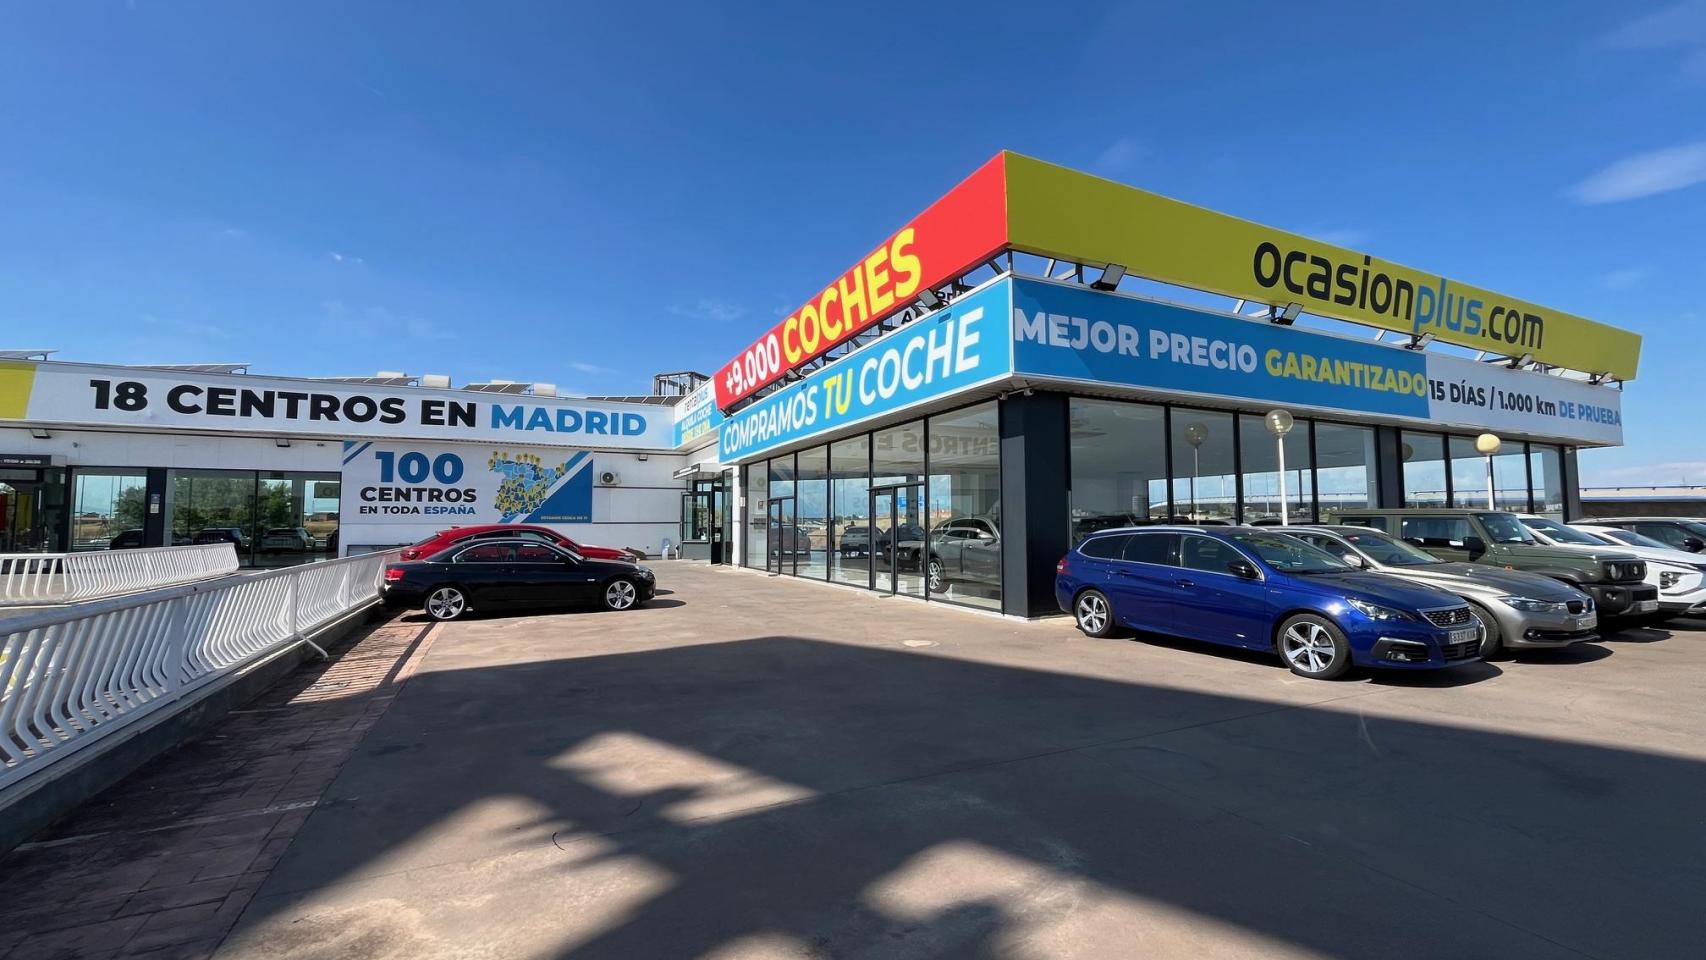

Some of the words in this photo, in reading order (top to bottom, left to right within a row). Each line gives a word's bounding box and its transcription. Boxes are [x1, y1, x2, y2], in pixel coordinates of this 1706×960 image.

[726, 333, 780, 396] +9.000
[783, 228, 921, 364] COCHES
[1253, 241, 1544, 349] ocasionplus.com
[724, 385, 817, 455] COMPRAMOS
[823, 368, 854, 420] TU
[859, 306, 984, 406] COCHE
[1014, 308, 1140, 358] MEJOR
[1149, 329, 1258, 374] PRECIO
[1265, 348, 1426, 397] GARANTIZADO
[90, 379, 148, 411] 18
[167, 384, 406, 425] CENTROS
[421, 400, 477, 428] EN
[491, 404, 647, 437] MADRID
[1429, 379, 1445, 401] 15
[1450, 379, 1486, 407] DÍAS
[1499, 390, 1533, 414] 1.000
[1536, 396, 1556, 417] km
[1559, 400, 1575, 420] DE
[1578, 403, 1622, 427] PRUEBA
[360, 486, 477, 503] CENTROS
[375, 451, 464, 484] 100
[359, 506, 378, 515] EN
[382, 506, 420, 515] TODA
[424, 504, 476, 515] ESPAÑA
